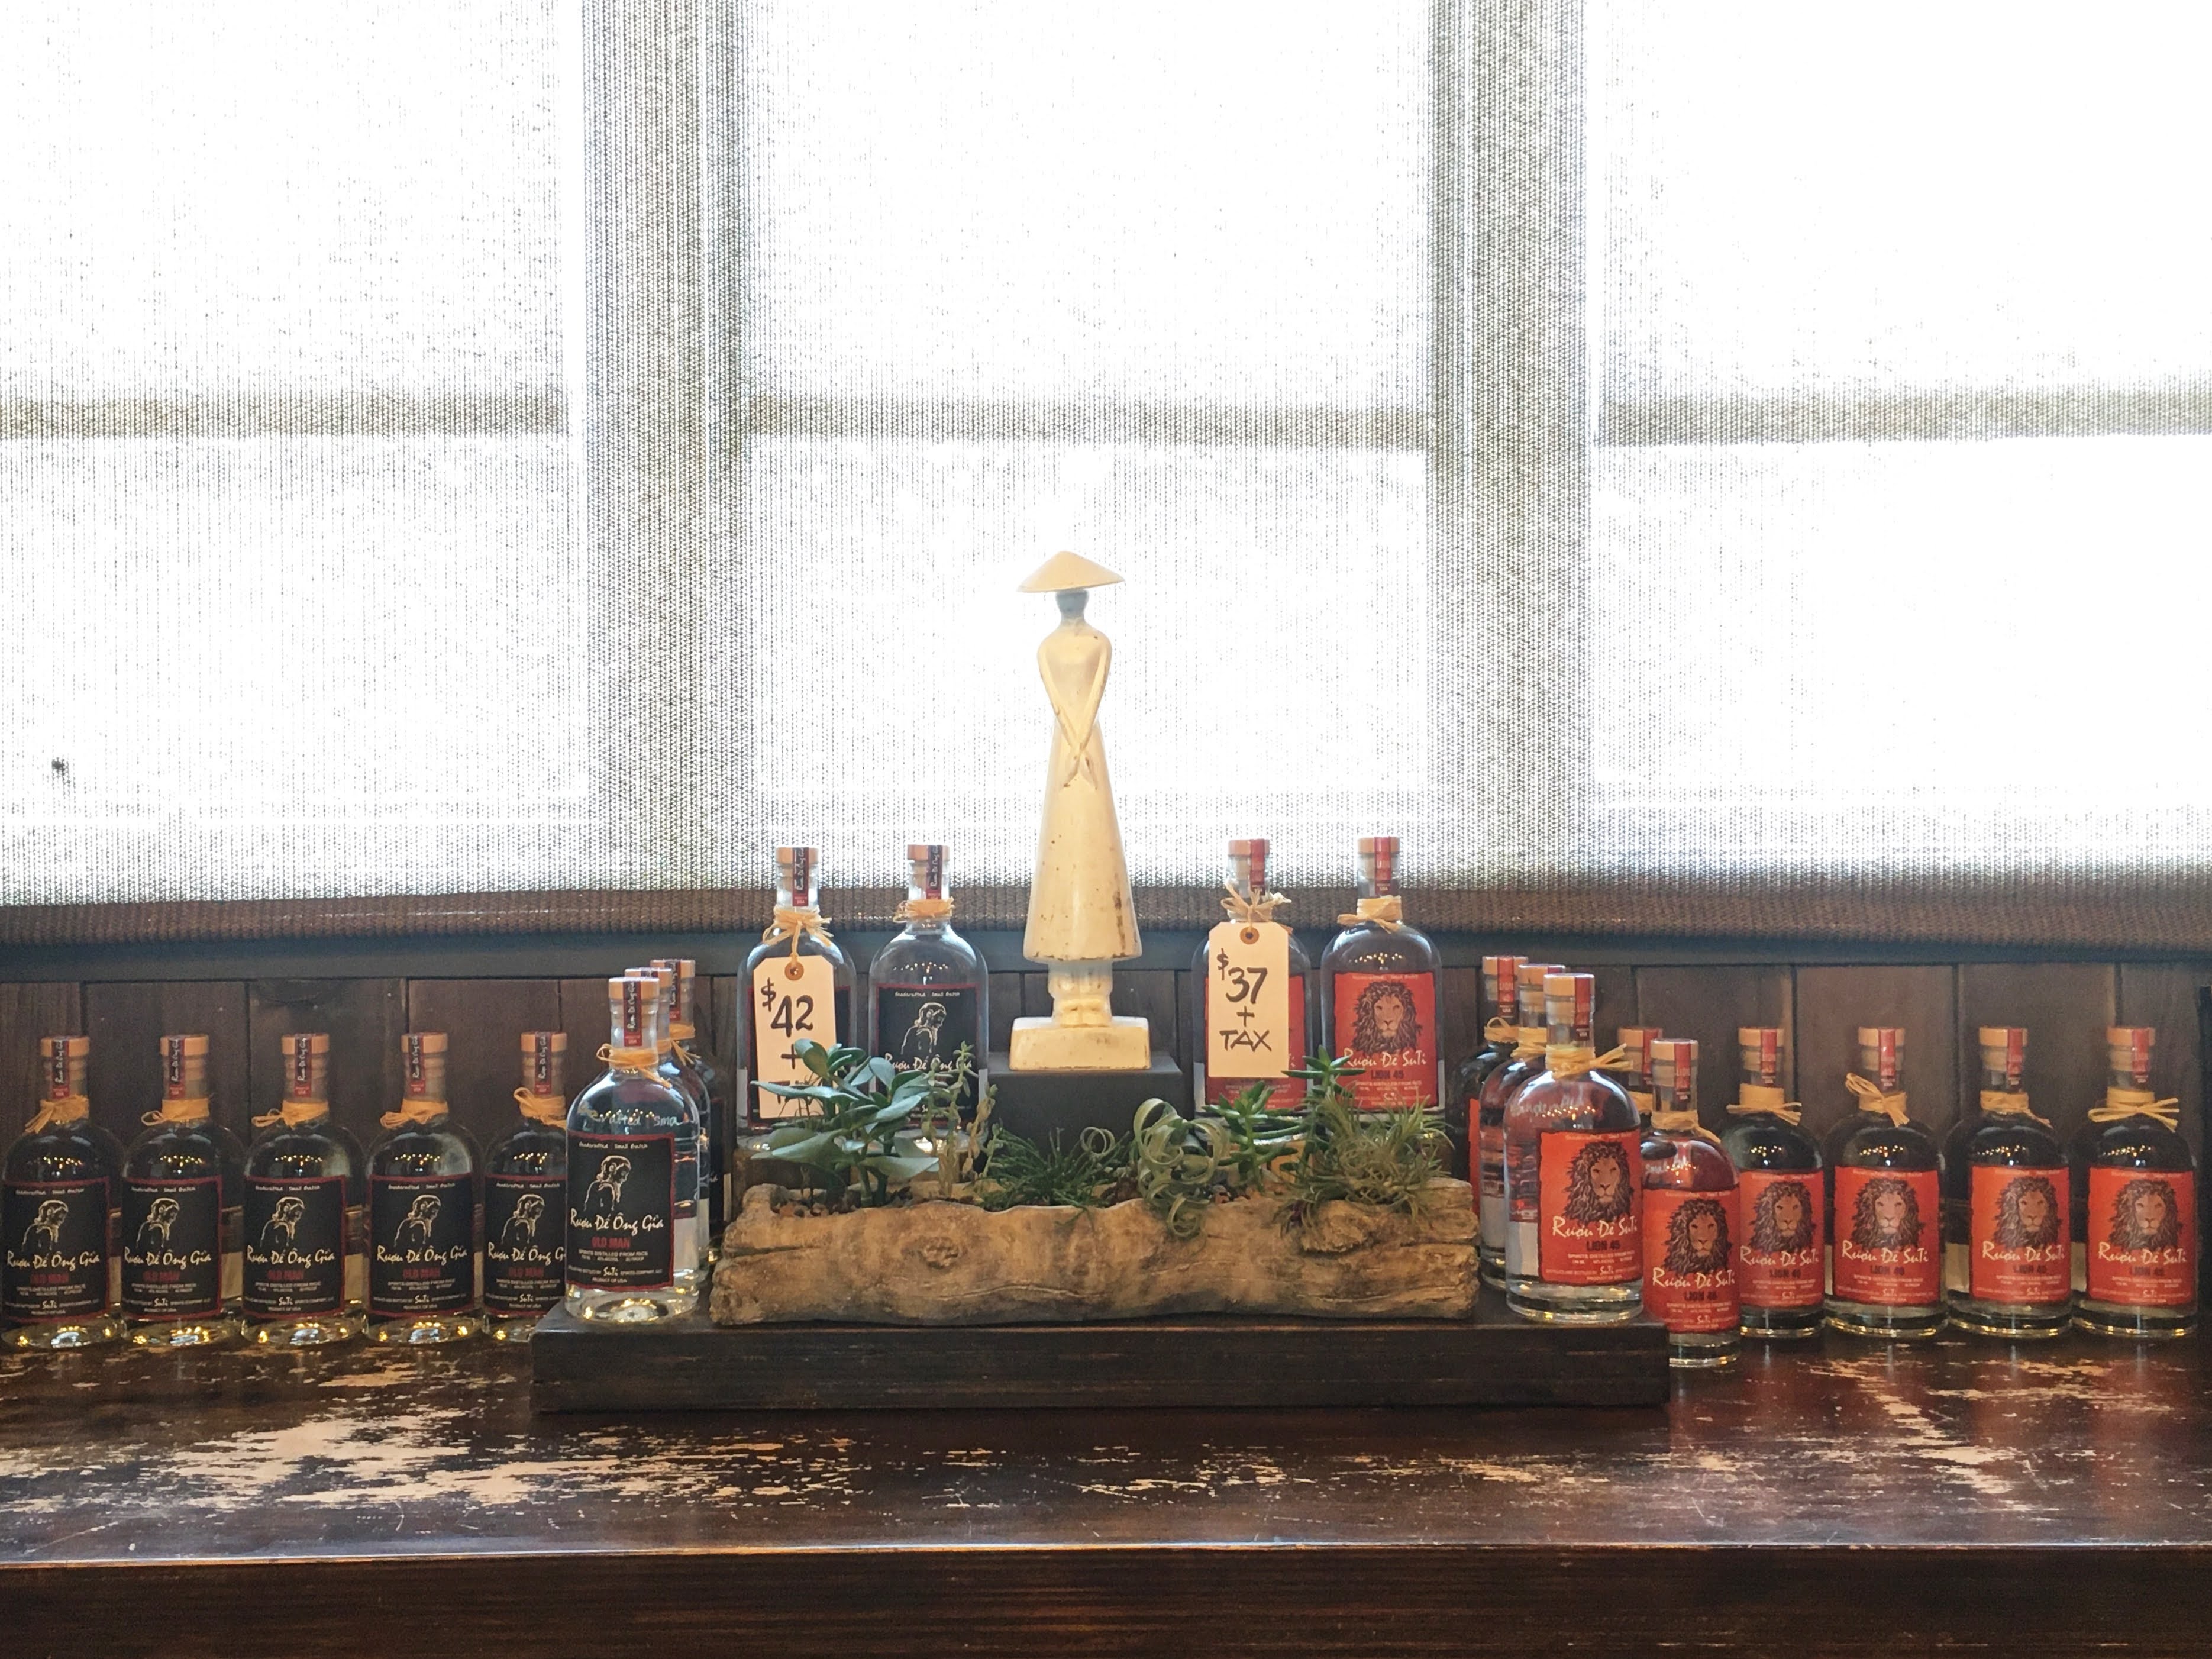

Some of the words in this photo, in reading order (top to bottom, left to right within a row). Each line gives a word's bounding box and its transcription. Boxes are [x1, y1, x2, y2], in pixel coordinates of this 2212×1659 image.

[1216, 948, 1268, 1004] $37
[761, 977, 813, 1037] $42
[1236, 1006, 1255, 1027] +
[1219, 1029, 1272, 1052] TAX
[1402, 1050, 1427, 1067] SuTi
[613, 1212, 638, 1236] Ông
[1618, 1216, 1638, 1236] SuTi
[424, 1245, 447, 1266] Ông
[529, 1245, 551, 1266] Ông
[1586, 1240, 1607, 1251] LION
[1903, 1247, 1929, 1264] SuTi
[2045, 1244, 2065, 1262] SuTi
[51, 1251, 76, 1271] Ông
[163, 1249, 187, 1270] Ông
[288, 1247, 312, 1269] Ông
[2163, 1248, 2187, 1266] SuTi
[1716, 1269, 1736, 1288] SuTi
